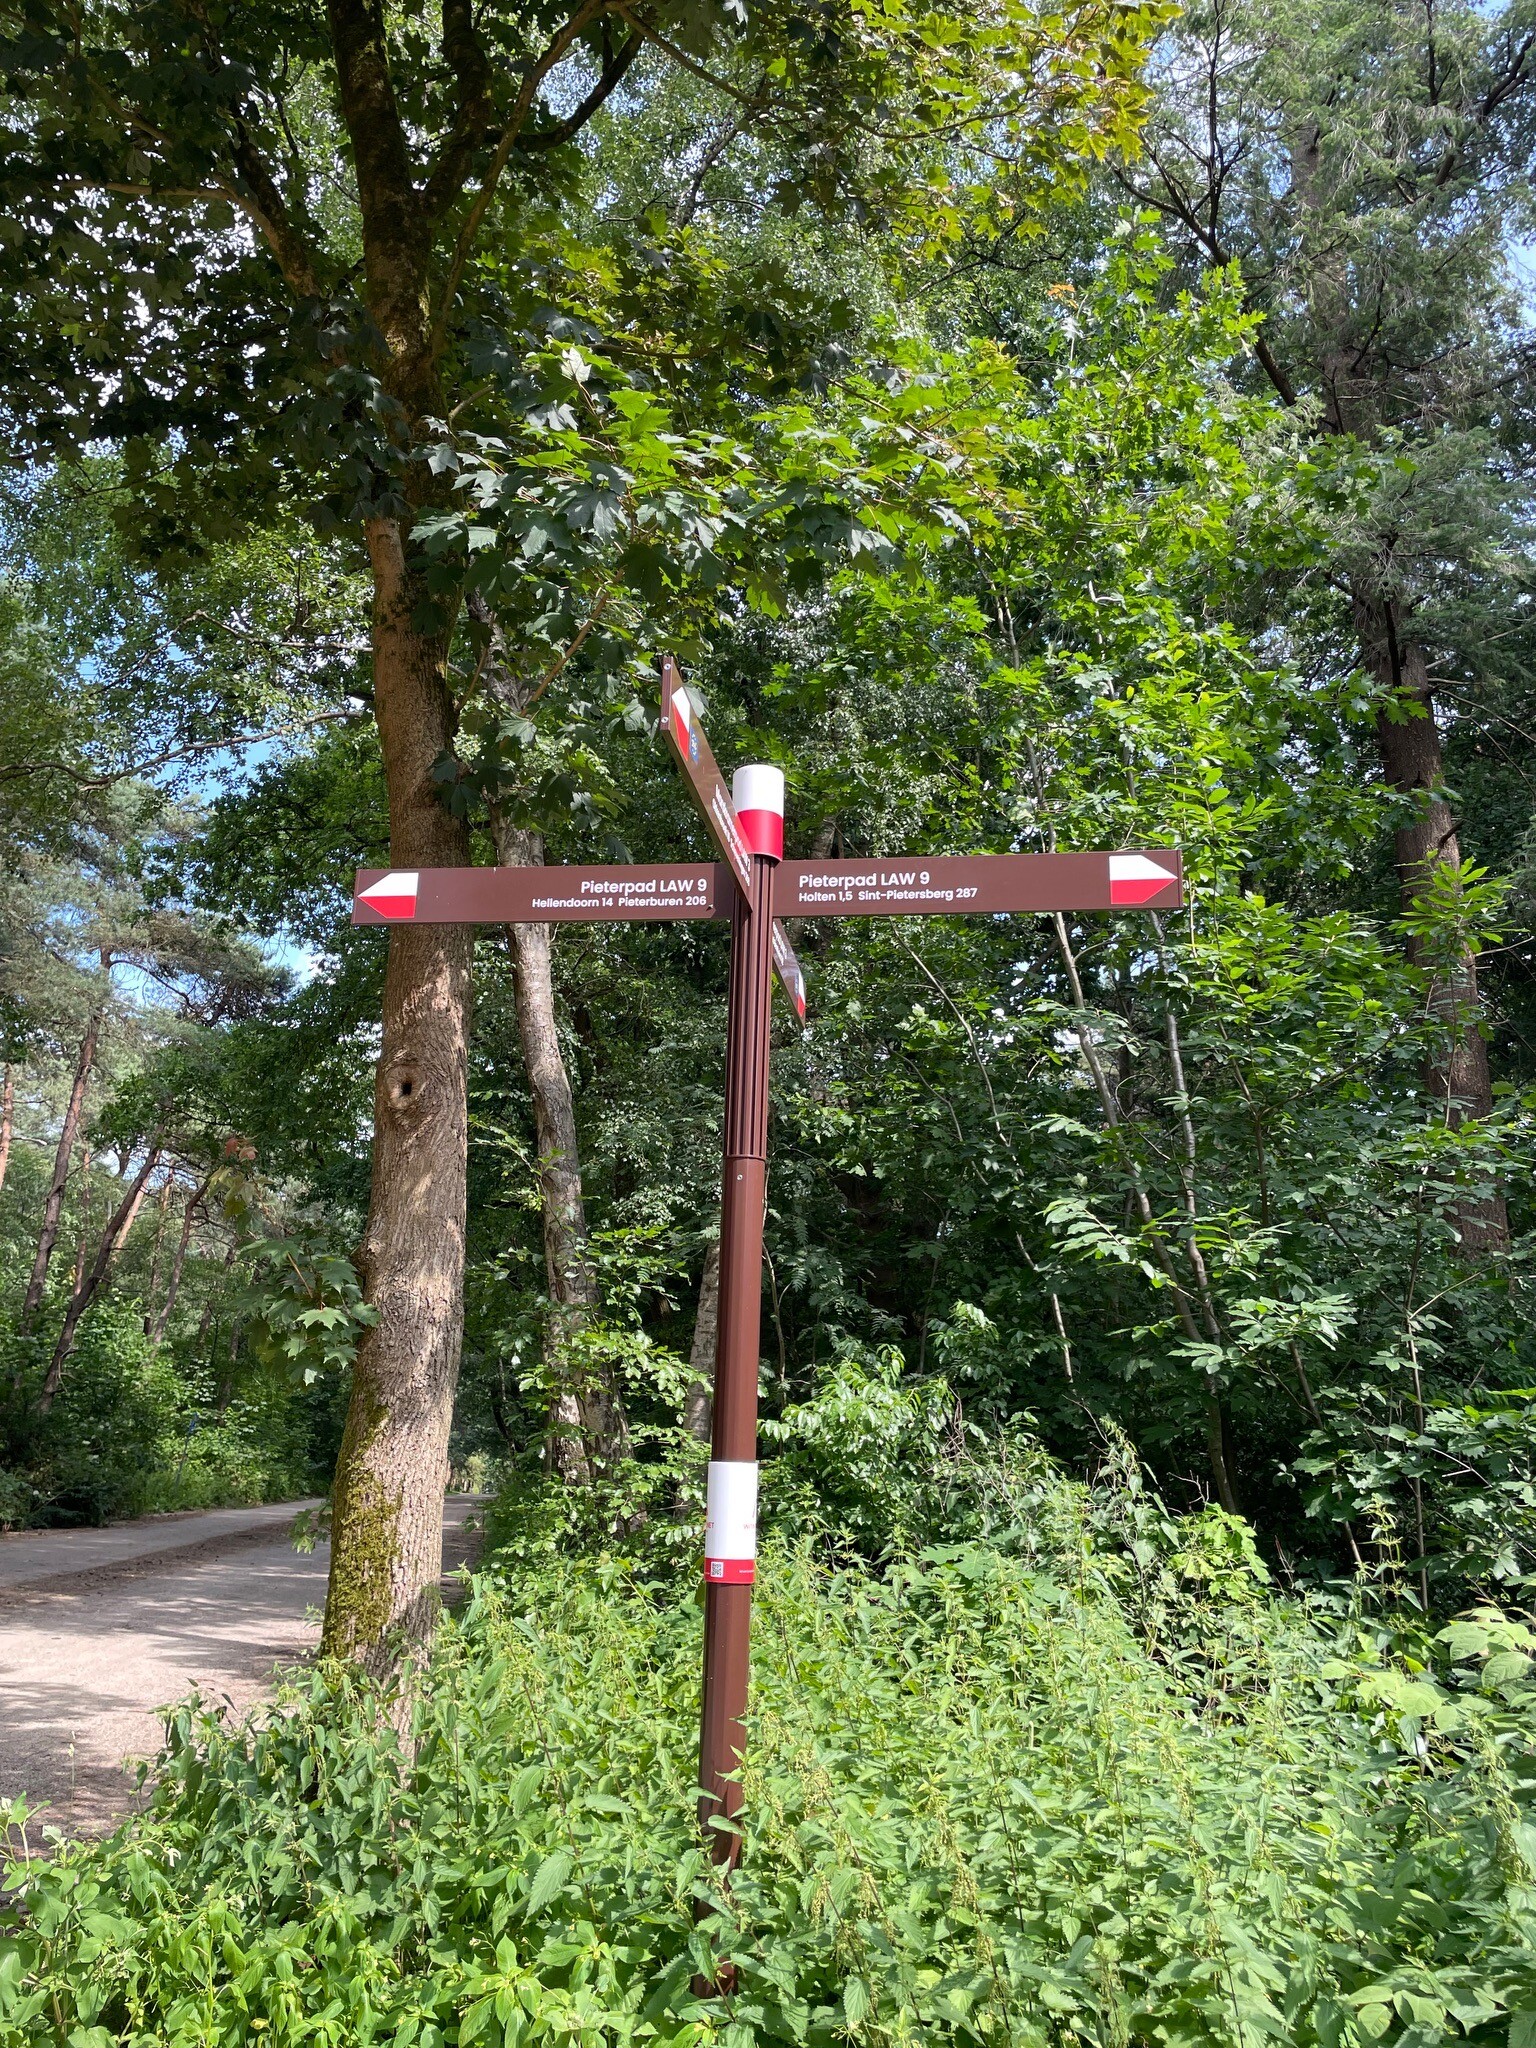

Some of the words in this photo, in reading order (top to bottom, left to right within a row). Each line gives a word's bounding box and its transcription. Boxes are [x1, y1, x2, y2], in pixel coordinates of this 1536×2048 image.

[580, 879, 657, 897] Pieterpad
[659, 879, 694, 893] LAW
[697, 878, 708, 892] 9
[798, 872, 878, 891] Pieterpad
[880, 872, 917, 886] LAW
[919, 870, 931, 885] 9
[531, 897, 600, 908] Hellendoorn
[601, 897, 614, 907] 14
[617, 896, 684, 907] Pieterburen
[685, 895, 707, 906] 206
[798, 891, 837, 903] Holten
[838, 890, 854, 903] 1,5
[857, 888, 954, 902] Sint-Pietersberg
[955, 887, 978, 899] 287
